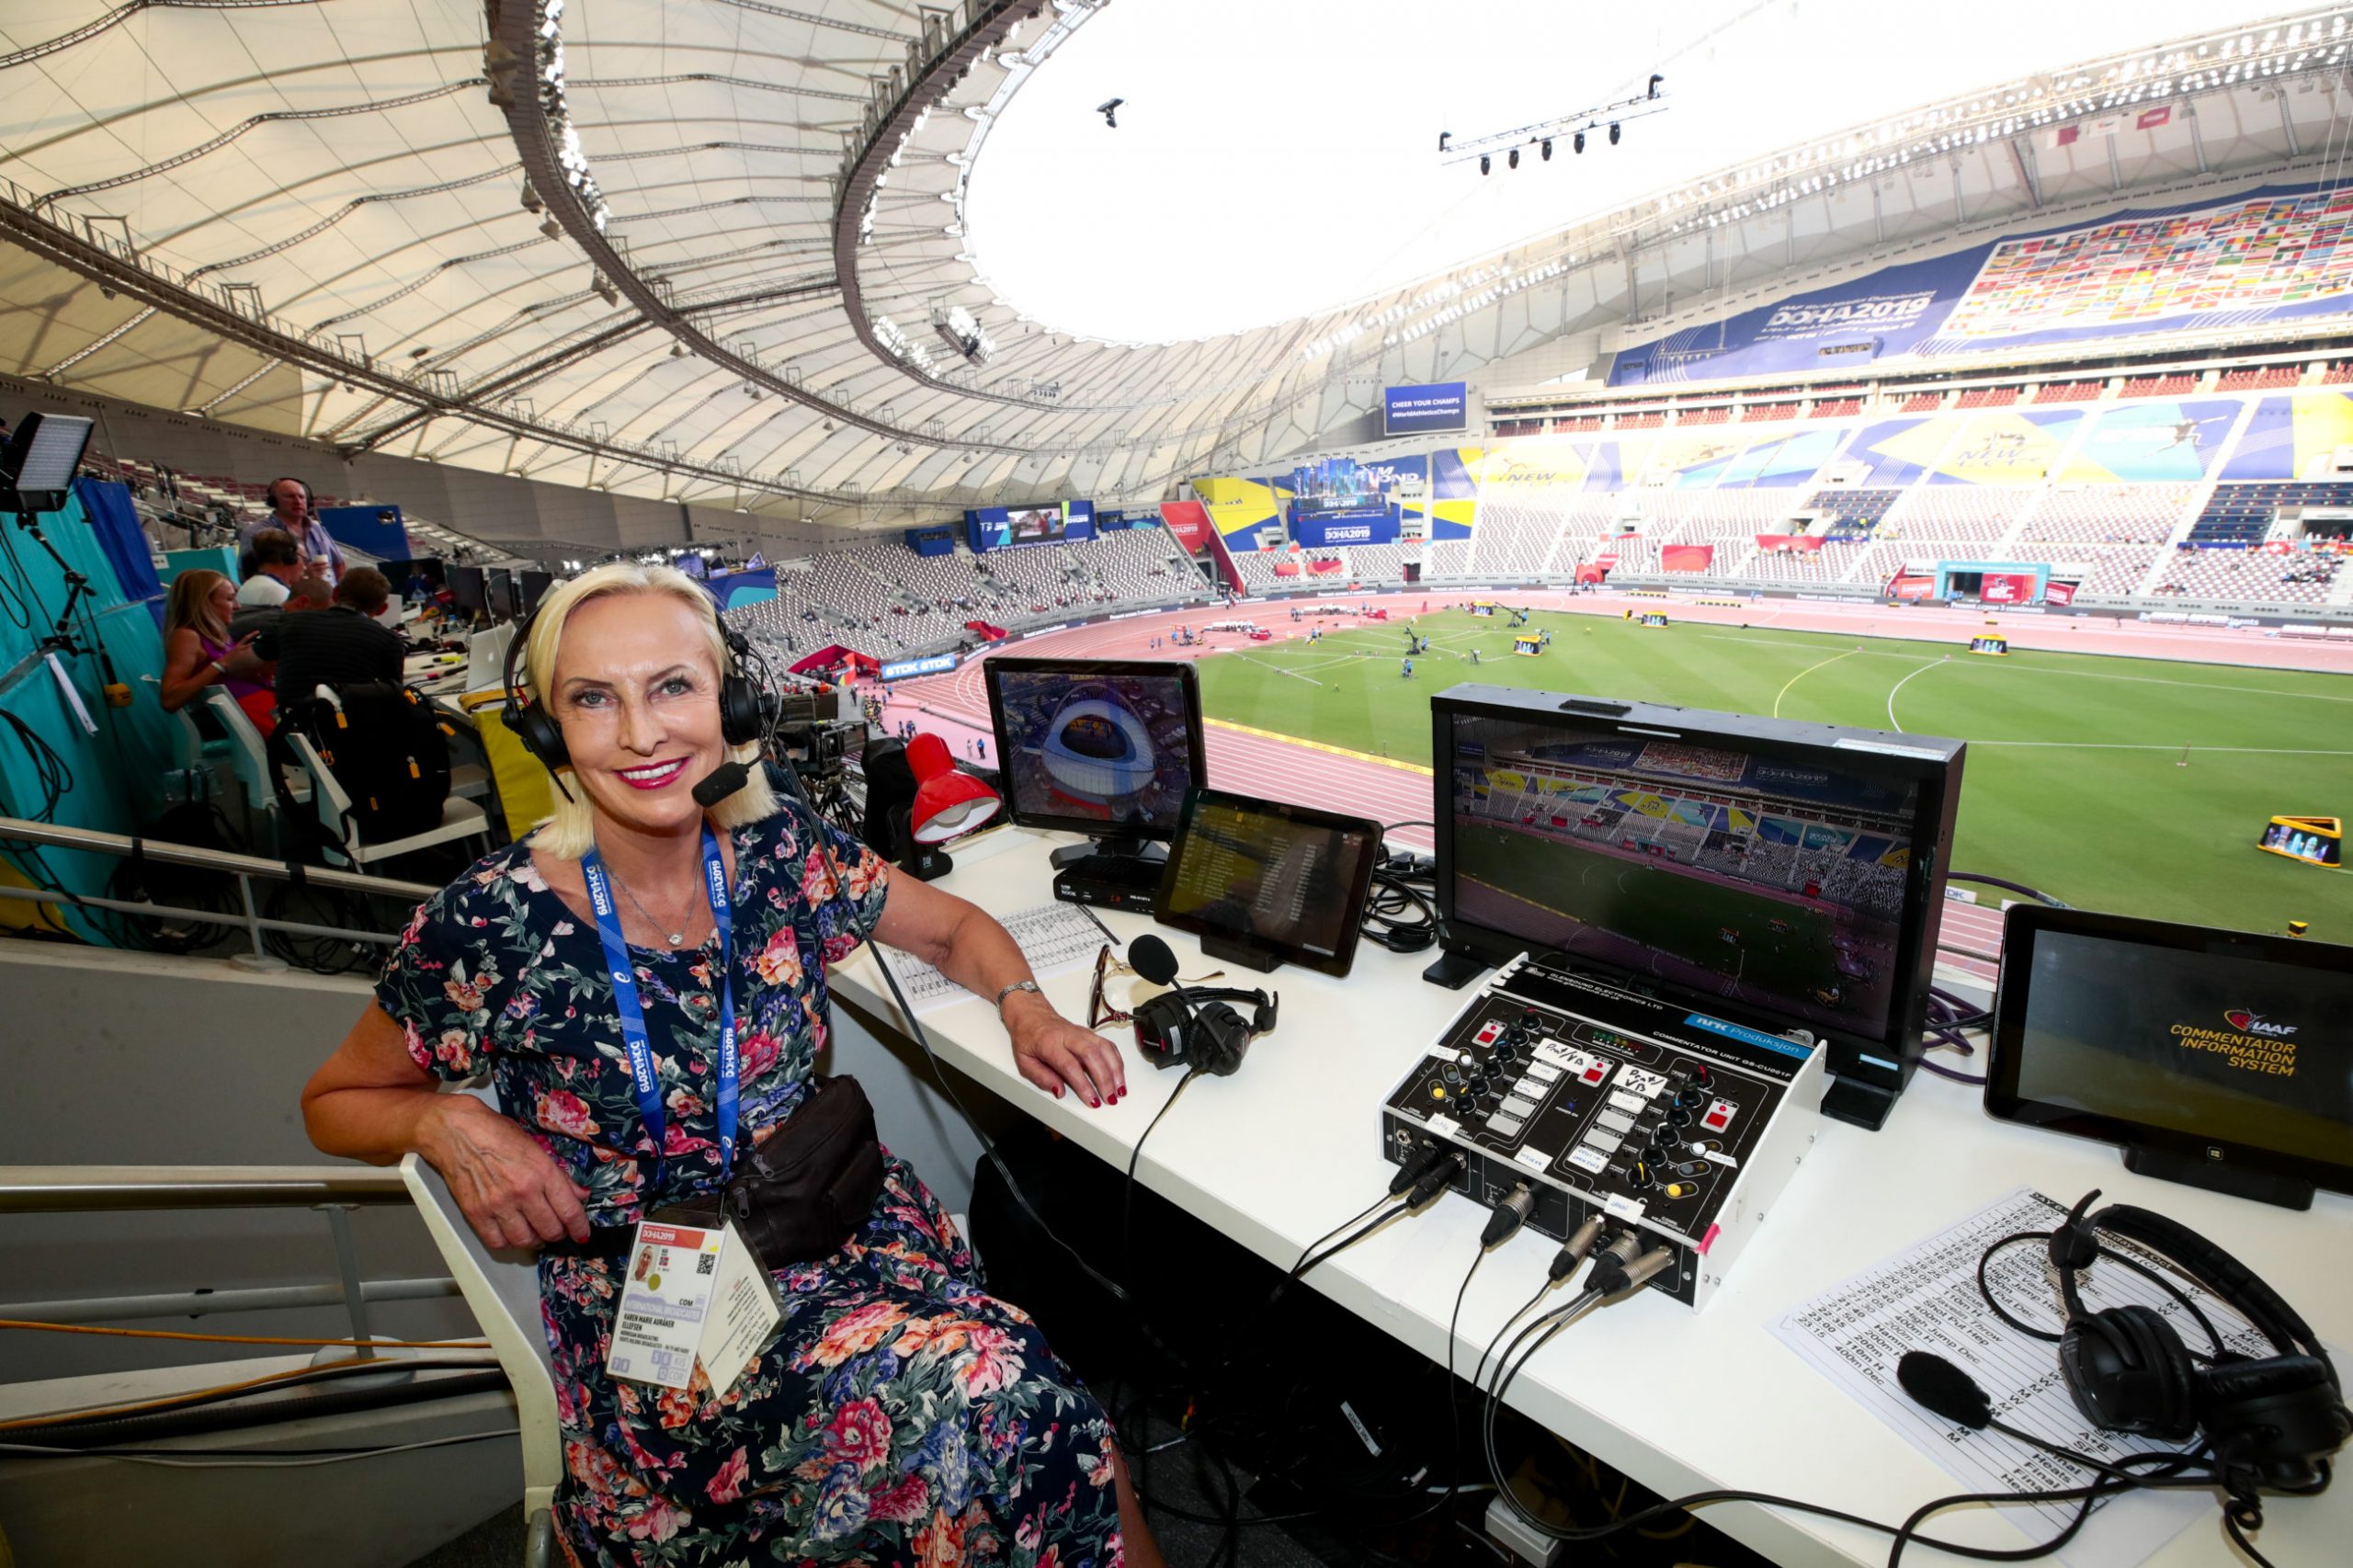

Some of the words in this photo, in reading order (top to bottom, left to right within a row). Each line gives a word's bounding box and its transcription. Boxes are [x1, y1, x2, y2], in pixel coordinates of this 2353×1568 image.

[1767, 297, 1931, 326] DOHA2019
[1324, 529, 1370, 540] DOHA2019
[893, 662, 918, 675] TDK
[927, 657, 951, 670] TDK
[586, 866, 608, 916] DOHA2019
[710, 860, 726, 908] DOHA2019
[1947, 889, 1964, 899] DK
[1550, 972, 1594, 989] GLENSOUND
[1595, 986, 1646, 1006] ELECTRONICS
[1647, 1002, 1664, 1010] LTD
[1730, 1027, 1801, 1053] Produksjon
[2170, 1023, 2297, 1055] COMMENTATOR
[2253, 1021, 2298, 1036] IAAF
[724, 1028, 733, 1078] DOHA2019
[1653, 1030, 1719, 1055] COMMENTATOR
[1720, 1051, 1741, 1062] UNIT
[2180, 1037, 2296, 1066] INFORMATION
[630, 1041, 651, 1093] DOHA2019
[2228, 1056, 2296, 1077] SYSTEM
[2003, 1256, 2040, 1279] Discus
[2012, 1252, 2050, 1275] 1500m
[2019, 1247, 2049, 1265] Long
[2078, 1282, 2104, 1297] Dec
[2147, 1254, 2173, 1268] Oct
[1903, 1264, 1934, 1284] 20:05
[1940, 1290, 1972, 1310] 110m
[1984, 1266, 2013, 1283] High
[2012, 1283, 2042, 1301] Jump
[2040, 1301, 2066, 1317] Hep
[1995, 1261, 2020, 1278] Pole
[2019, 1278, 2049, 1295] Vault
[1836, 1297, 1867, 1318] 21:40
[1874, 1278, 1905, 1299] 20:35
[1912, 1304, 1943, 1325] 400m
[1884, 1274, 1915, 1294] 20:30
[1921, 1299, 1949, 1317] Shot
[1947, 1316, 1967, 1330] Put
[1963, 1329, 1991, 1346] Hep
[1949, 1284, 1986, 1308] Discus
[1993, 1291, 2014, 1304] Put
[2012, 1303, 2037, 1319] Dec
[622, 1321, 642, 1331] ELLEFSEN
[624, 1312, 638, 1322] KAREN
[639, 1315, 653, 1325] MARIE
[1883, 1320, 1915, 1342] 200m
[1931, 1294, 1970, 1320] Javelin
[1969, 1320, 2005, 1343] Throw
[1796, 1316, 1827, 1338] 23:15
[1833, 1345, 1864, 1368] 400m
[1860, 1367, 1887, 1385] Dec
[1806, 1311, 1837, 1333] 23:00
[1843, 1340, 1874, 1362] 110m
[2222, 1334, 2264, 1359] Heats
[2236, 1332, 2264, 1348] MC
[1893, 1314, 1924, 1335] 400m
[2072, 1439, 2096, 1456] SF
[1901, 1309, 1929, 1328] High
[1927, 1326, 1959, 1348] Jump
[1956, 1346, 1983, 1364] Dec
[2077, 1430, 2110, 1452] A+B
[1816, 1306, 1847, 1328] 22:35
[1852, 1335, 1885, 1358] 200m
[2022, 1460, 2061, 1489] Final
[1863, 1329, 1895, 1352] 200m
[2031, 1453, 2074, 1483] Heats
